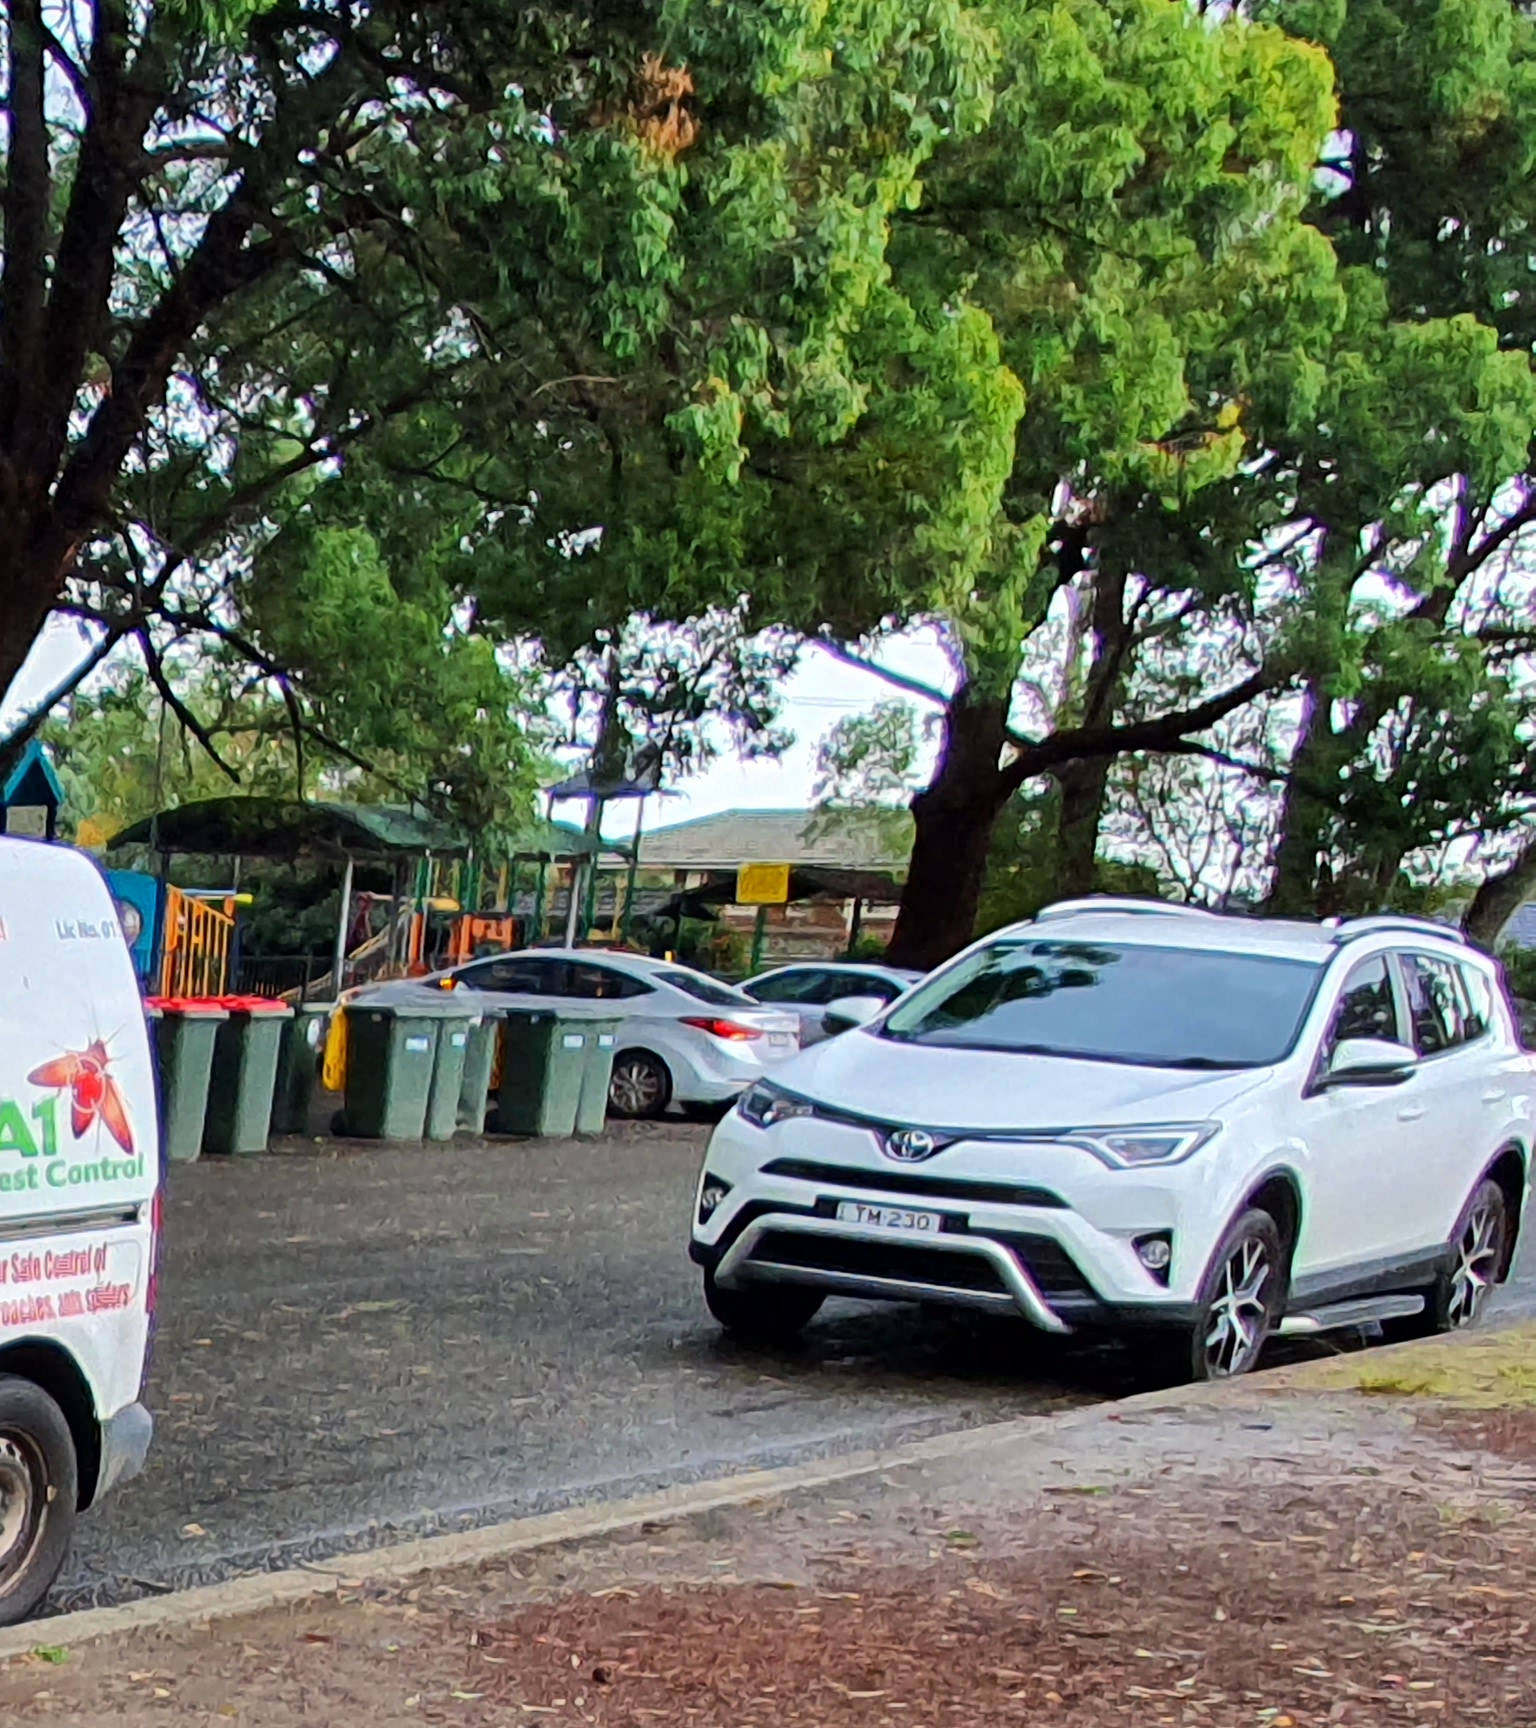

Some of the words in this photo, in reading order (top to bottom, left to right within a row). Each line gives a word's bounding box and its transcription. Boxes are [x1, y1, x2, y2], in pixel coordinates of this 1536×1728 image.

[45, 1151, 145, 1188] Control
[11, 1251, 42, 1284] Safe
[45, 1243, 93, 1279] Control
[94, 1240, 109, 1275] of
